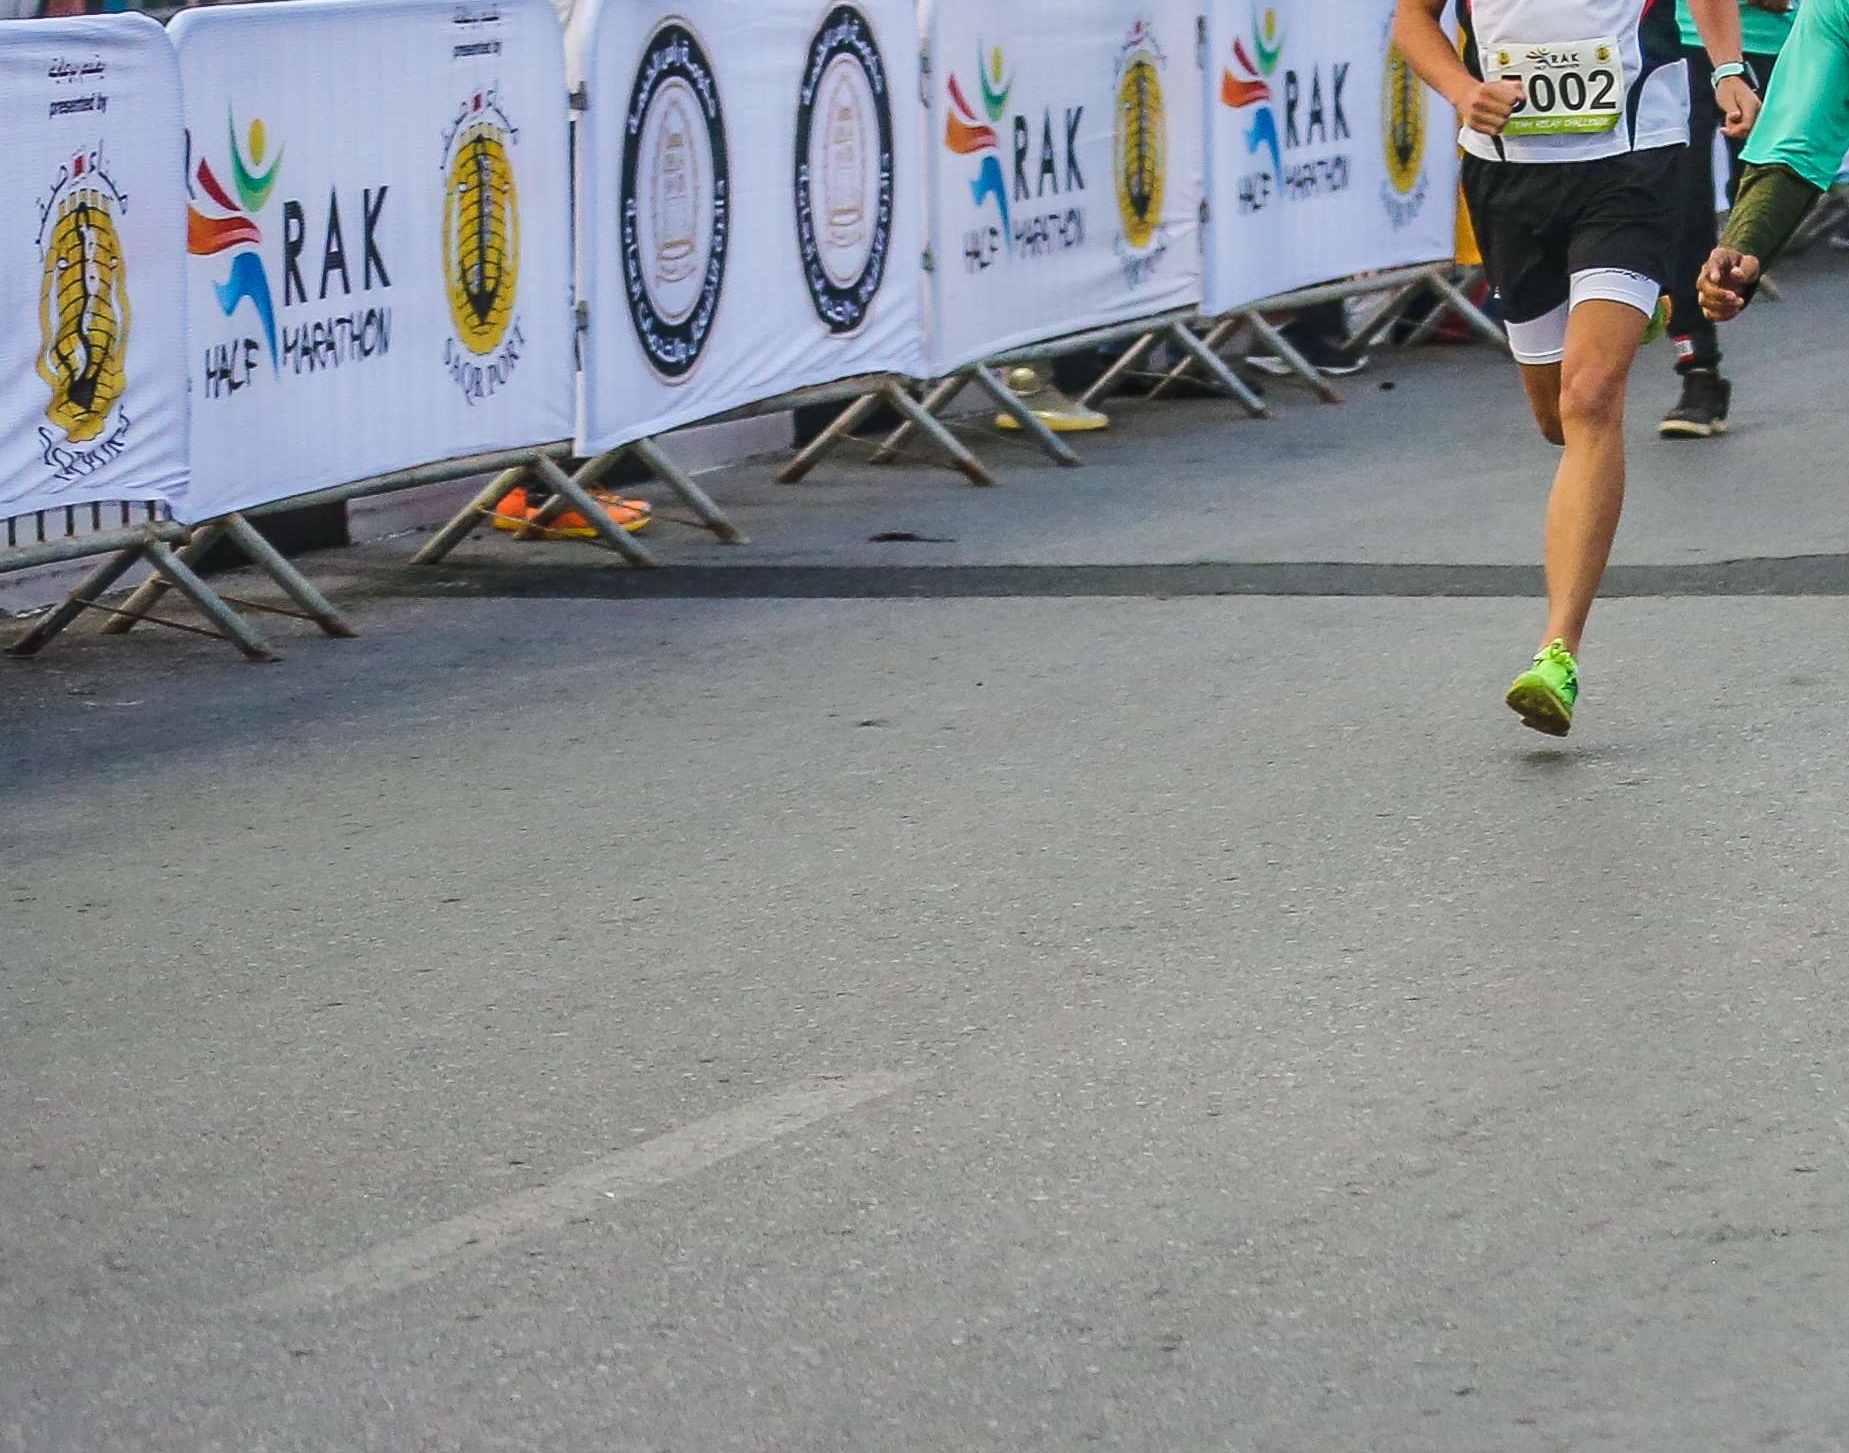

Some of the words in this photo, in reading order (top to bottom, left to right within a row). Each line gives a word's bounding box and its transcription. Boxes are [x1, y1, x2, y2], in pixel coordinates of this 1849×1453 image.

[1550, 52, 1580, 64] RAK
[1284, 61, 1352, 150] RAK
[1014, 105, 1085, 202] RAK
[284, 181, 392, 307] RAK
[205, 337, 260, 399] HALF
[282, 307, 392, 375] MARATHON
